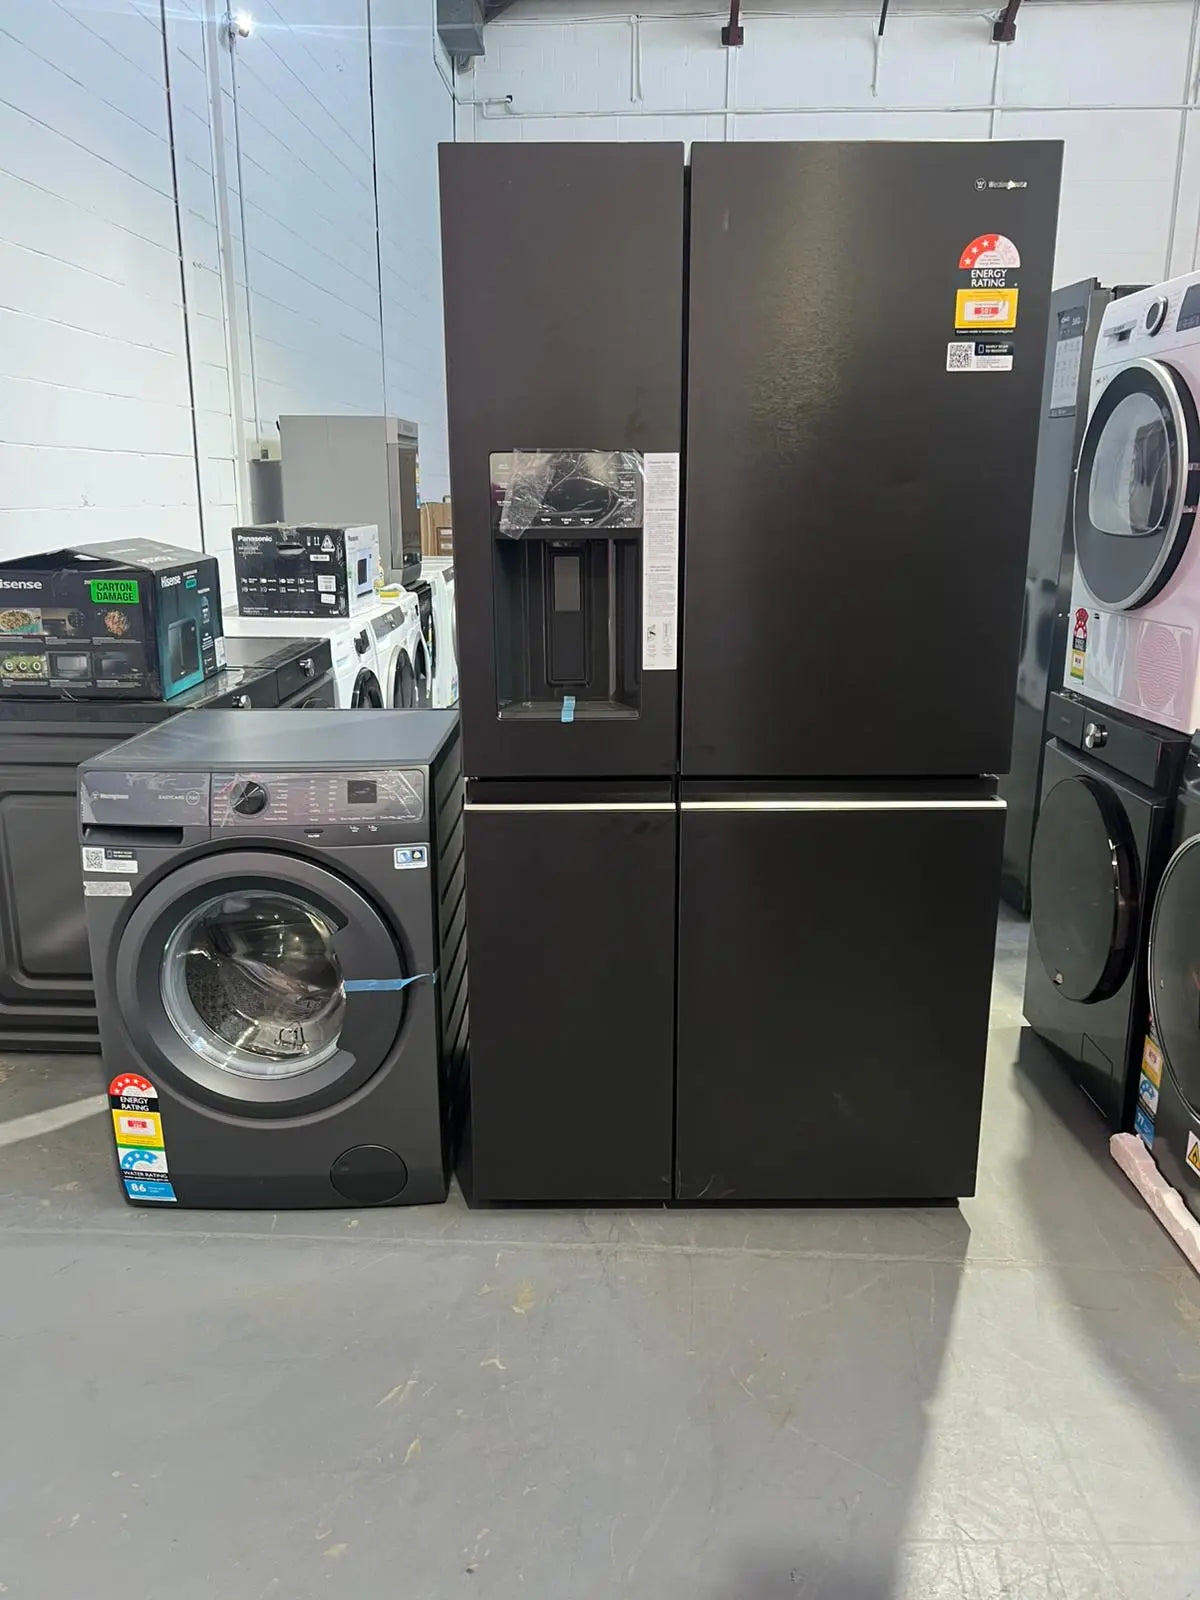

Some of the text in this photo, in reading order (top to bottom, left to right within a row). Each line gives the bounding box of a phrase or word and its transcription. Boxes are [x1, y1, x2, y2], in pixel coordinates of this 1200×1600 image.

[970, 269, 1007, 278] ENERGY
[971, 279, 1006, 287] RATING
[237, 535, 273, 543] Panasonic
[160, 575, 182, 588] Hisense
[96, 582, 132, 591] CARTON
[96, 591, 134, 601] DAMAGE
[120, 1096, 149, 1104] ENERGY
[130, 1183, 147, 1193] 86
